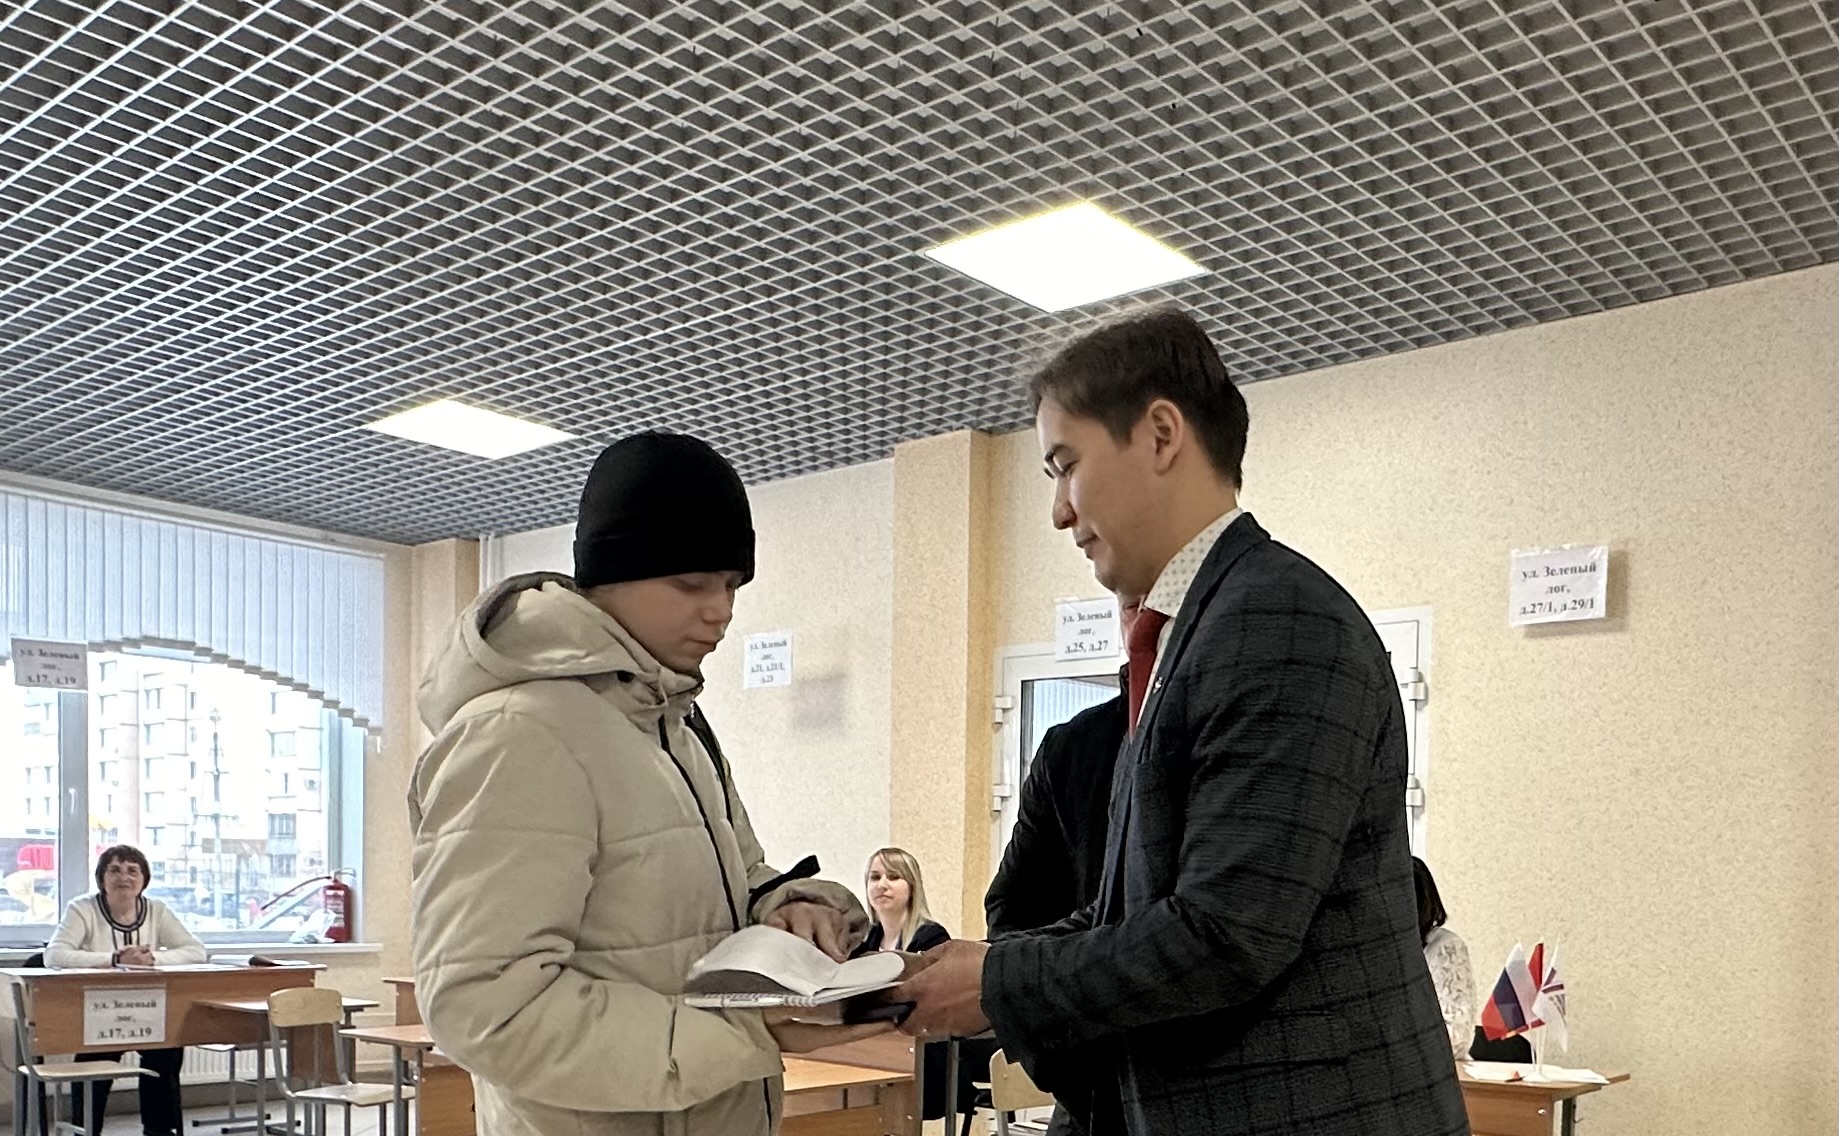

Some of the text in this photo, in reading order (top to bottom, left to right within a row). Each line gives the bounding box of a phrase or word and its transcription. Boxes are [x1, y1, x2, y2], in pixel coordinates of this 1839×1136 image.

[1543, 561, 1597, 577] Зеленый
[1077, 610, 1112, 621] Зеленый
[1088, 640, 1109, 652] д.27
[112, 1000, 157, 1009] Зеленый
